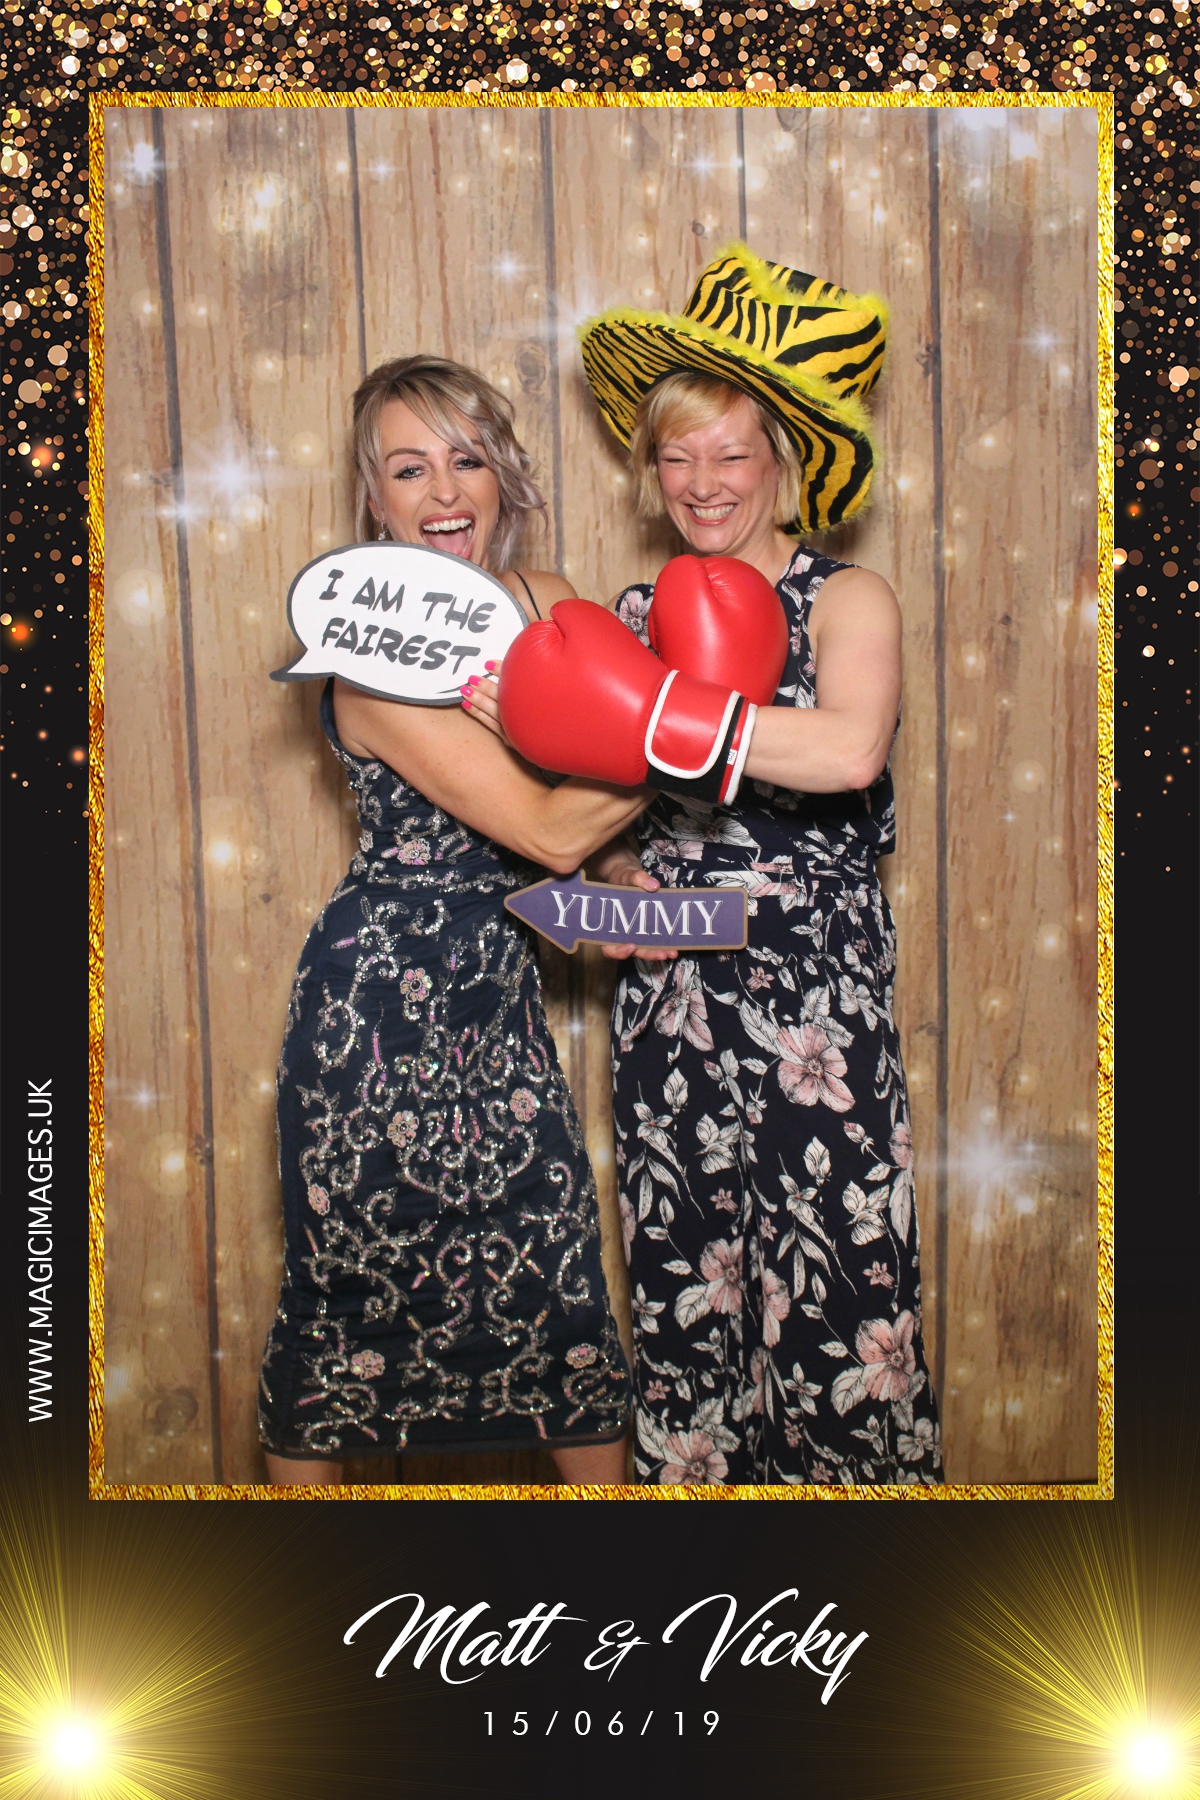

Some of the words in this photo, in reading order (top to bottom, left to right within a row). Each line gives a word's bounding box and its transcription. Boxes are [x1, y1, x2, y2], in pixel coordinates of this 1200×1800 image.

[319, 568, 344, 601] I
[351, 576, 406, 614] AM
[422, 591, 497, 634] THE
[321, 617, 482, 676] FAIREST
[550, 890, 724, 937] YUMMY
